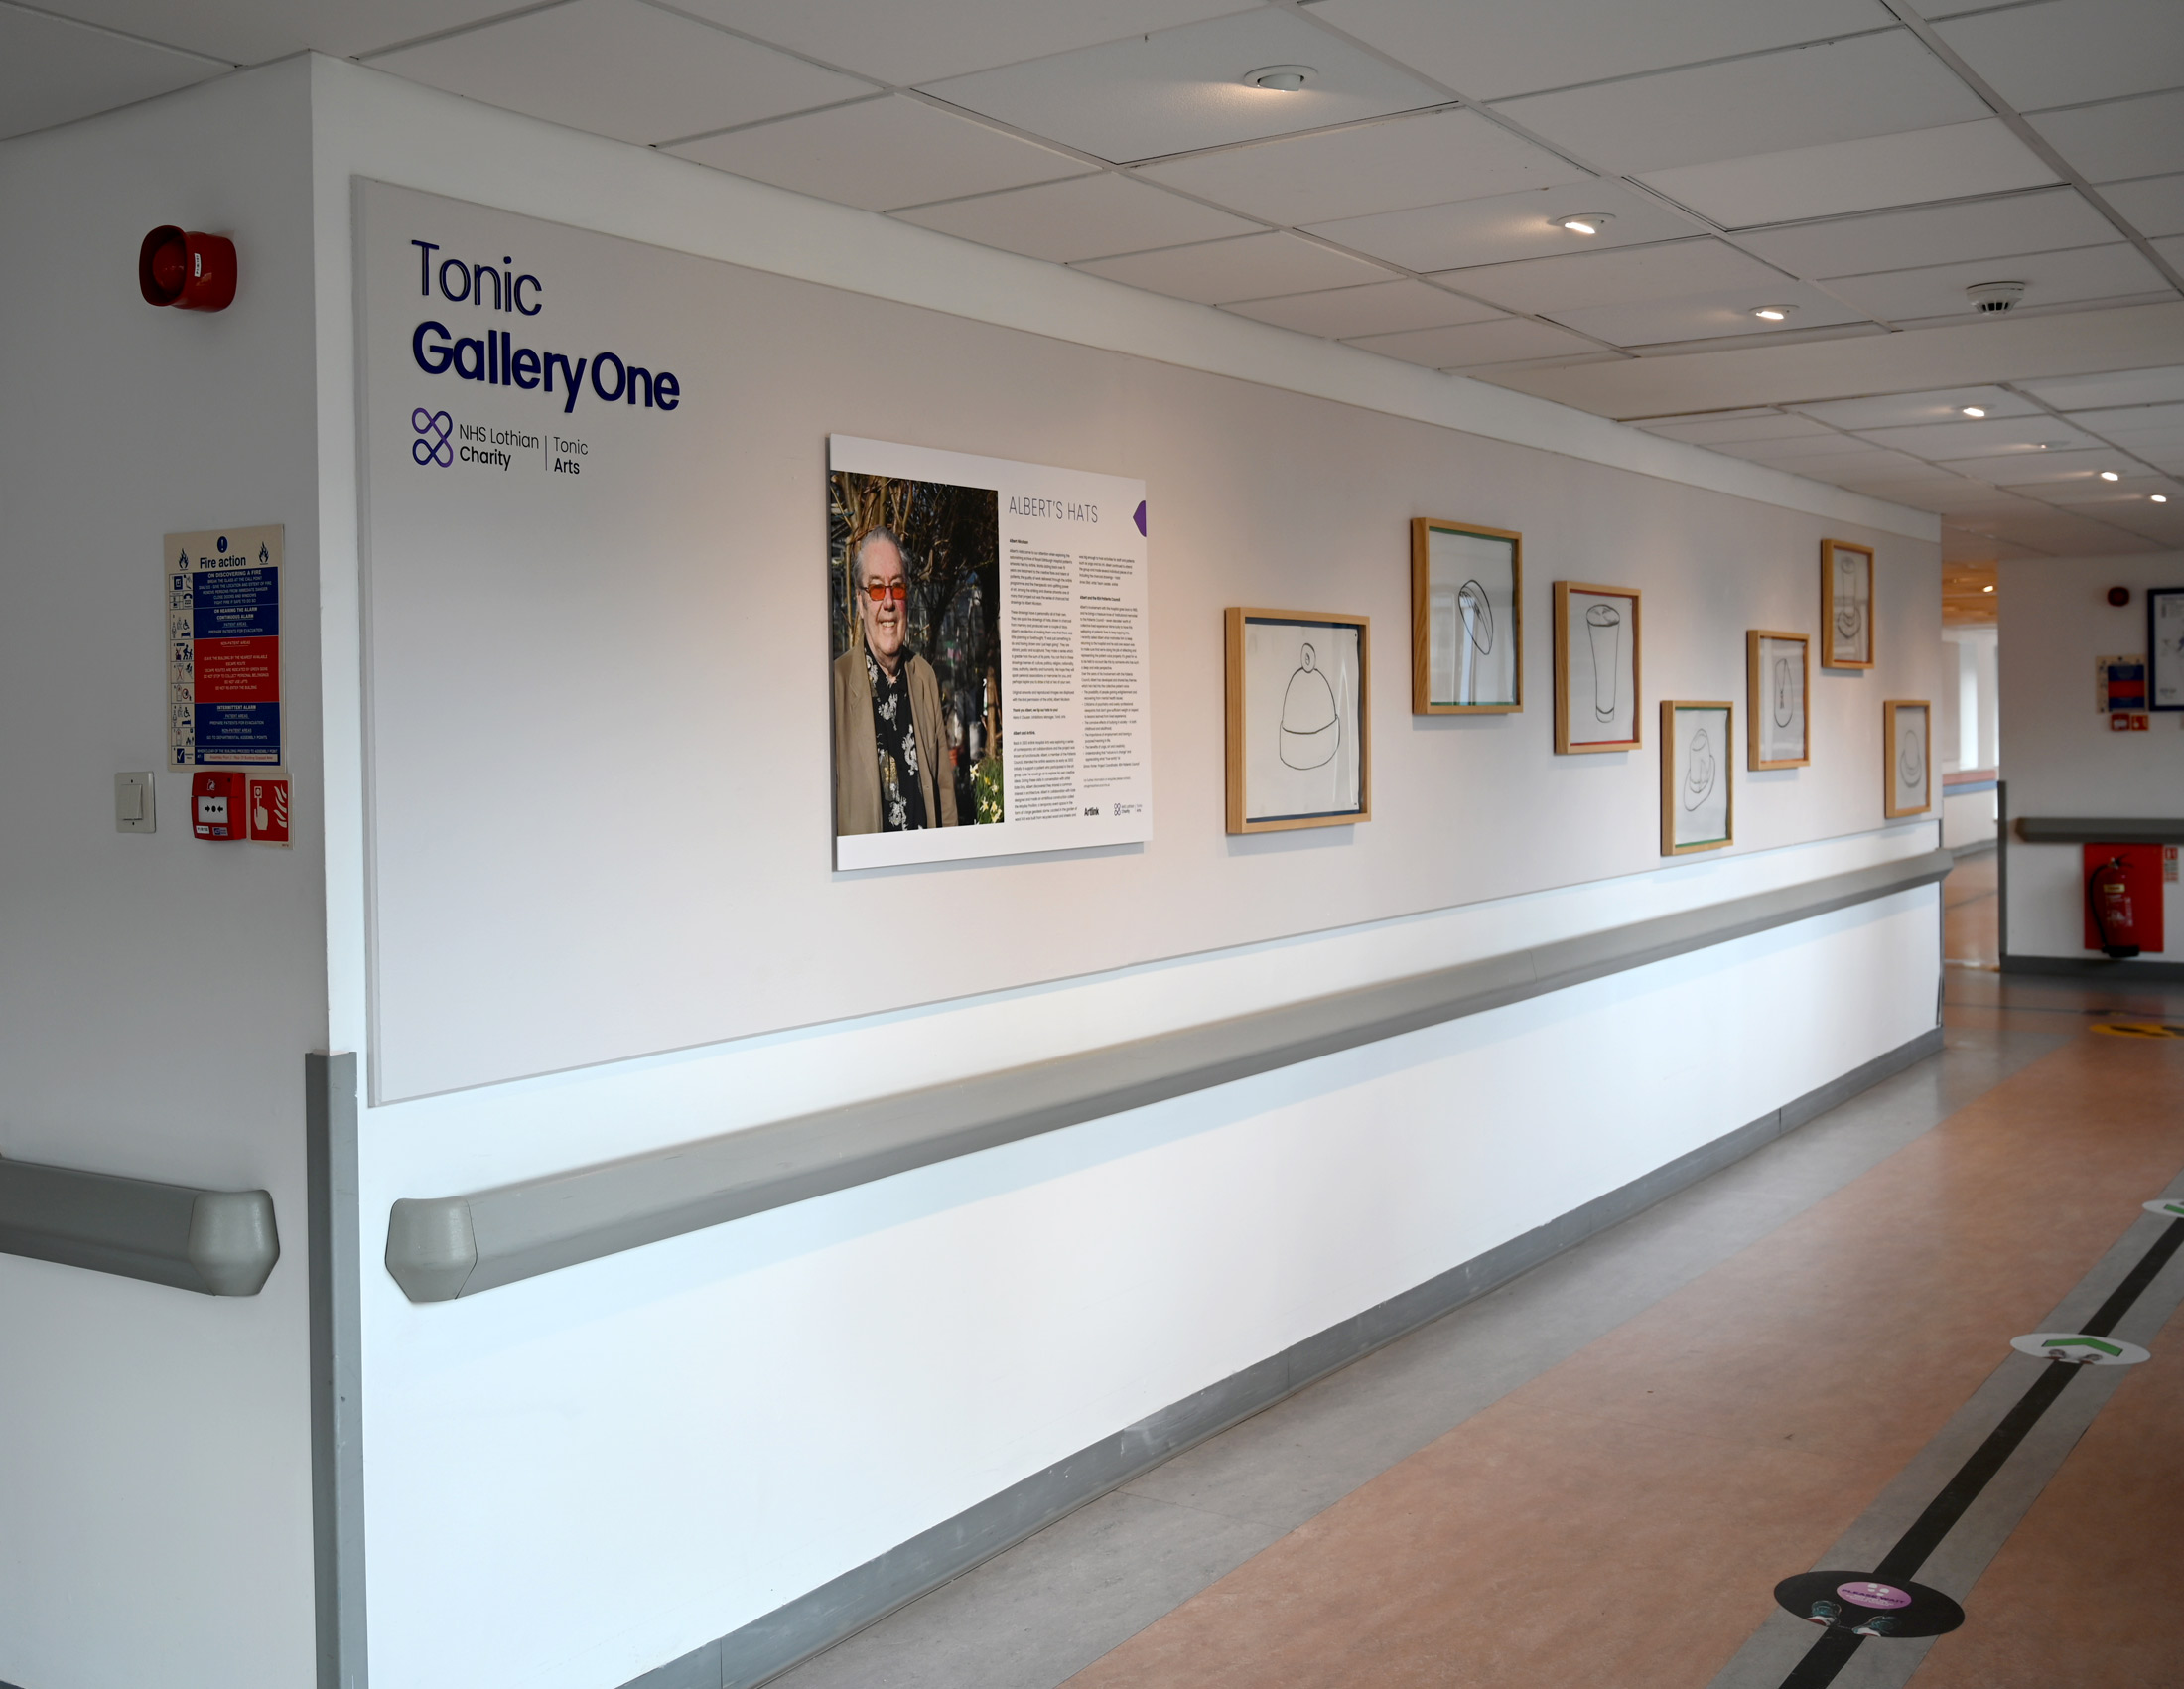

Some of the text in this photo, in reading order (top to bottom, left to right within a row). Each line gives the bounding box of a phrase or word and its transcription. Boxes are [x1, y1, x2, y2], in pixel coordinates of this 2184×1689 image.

[411, 239, 542, 316] Tonic
[412, 321, 680, 413] Gallery One
[460, 424, 539, 449] NHS Lothian
[553, 437, 588, 455] Tonic
[460, 447, 511, 471] Charity
[554, 458, 580, 475] Arts
[1009, 496, 1098, 523] ALBERT'S HATS
[200, 555, 246, 569] Fire action
[1084, 806, 1099, 816] Artlink
[1842, 1589, 1877, 1599] PLEASE
